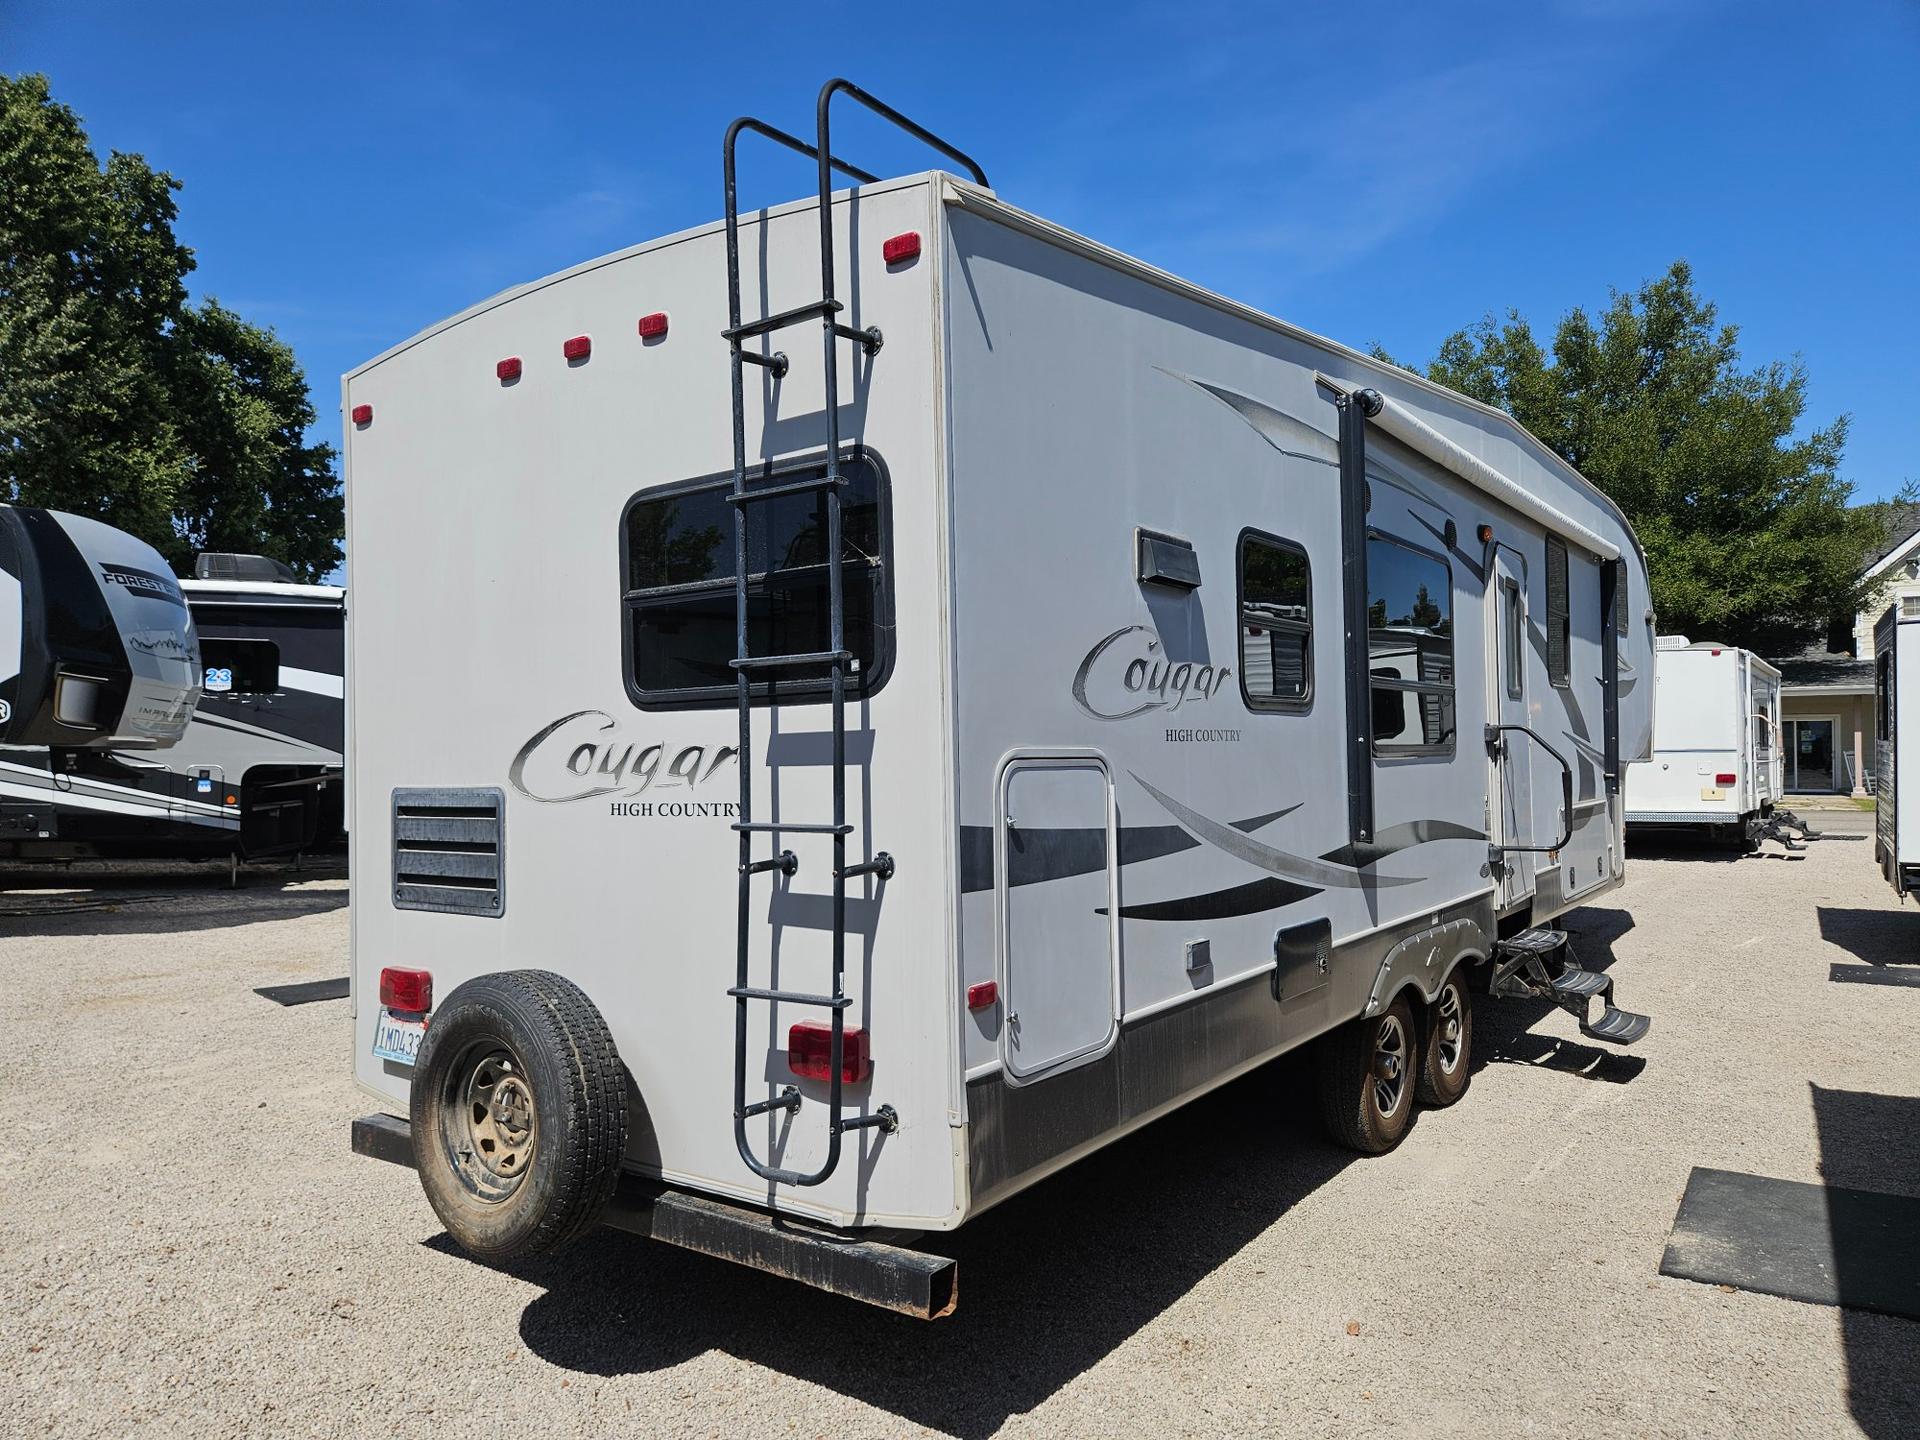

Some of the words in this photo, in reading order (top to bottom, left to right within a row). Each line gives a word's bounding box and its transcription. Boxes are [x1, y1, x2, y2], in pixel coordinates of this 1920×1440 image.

[102, 573, 163, 591] FOREST
[1072, 625, 1232, 719] Cougar
[1165, 729, 1193, 742] HIGH
[1195, 729, 1241, 742] COUNTRY
[508, 709, 740, 803] Cougar
[610, 802, 653, 817] HIGH
